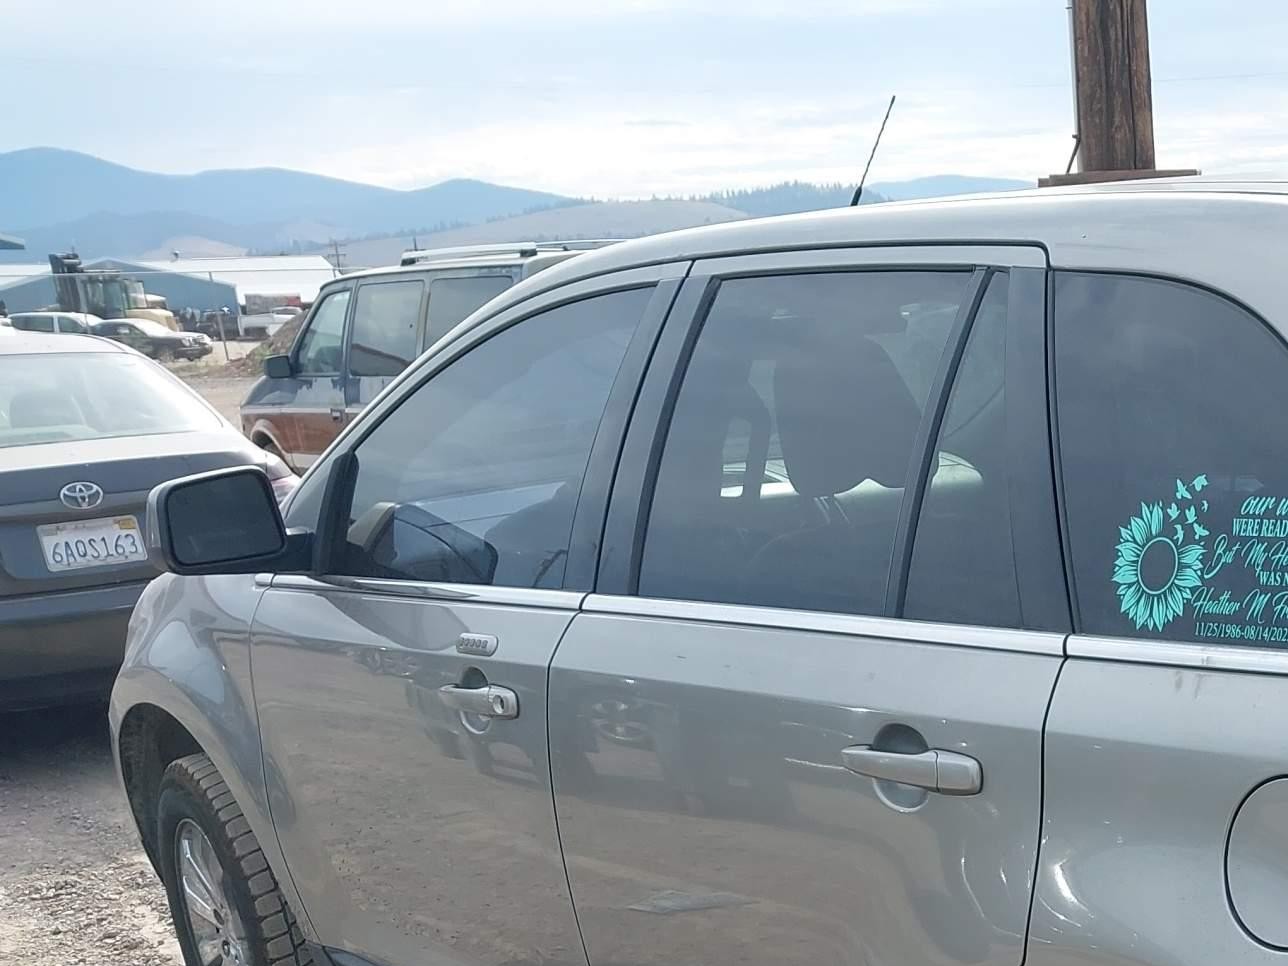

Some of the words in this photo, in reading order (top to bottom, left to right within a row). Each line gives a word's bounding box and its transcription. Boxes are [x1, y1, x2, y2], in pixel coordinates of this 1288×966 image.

[1232, 518, 1261, 537] WERE
[1204, 534, 1242, 579] But
[1241, 539, 1268, 577] My
[1259, 571, 1282, 587] WAS
[1190, 587, 1241, 619] Heather
[1242, 588, 1272, 624] M
